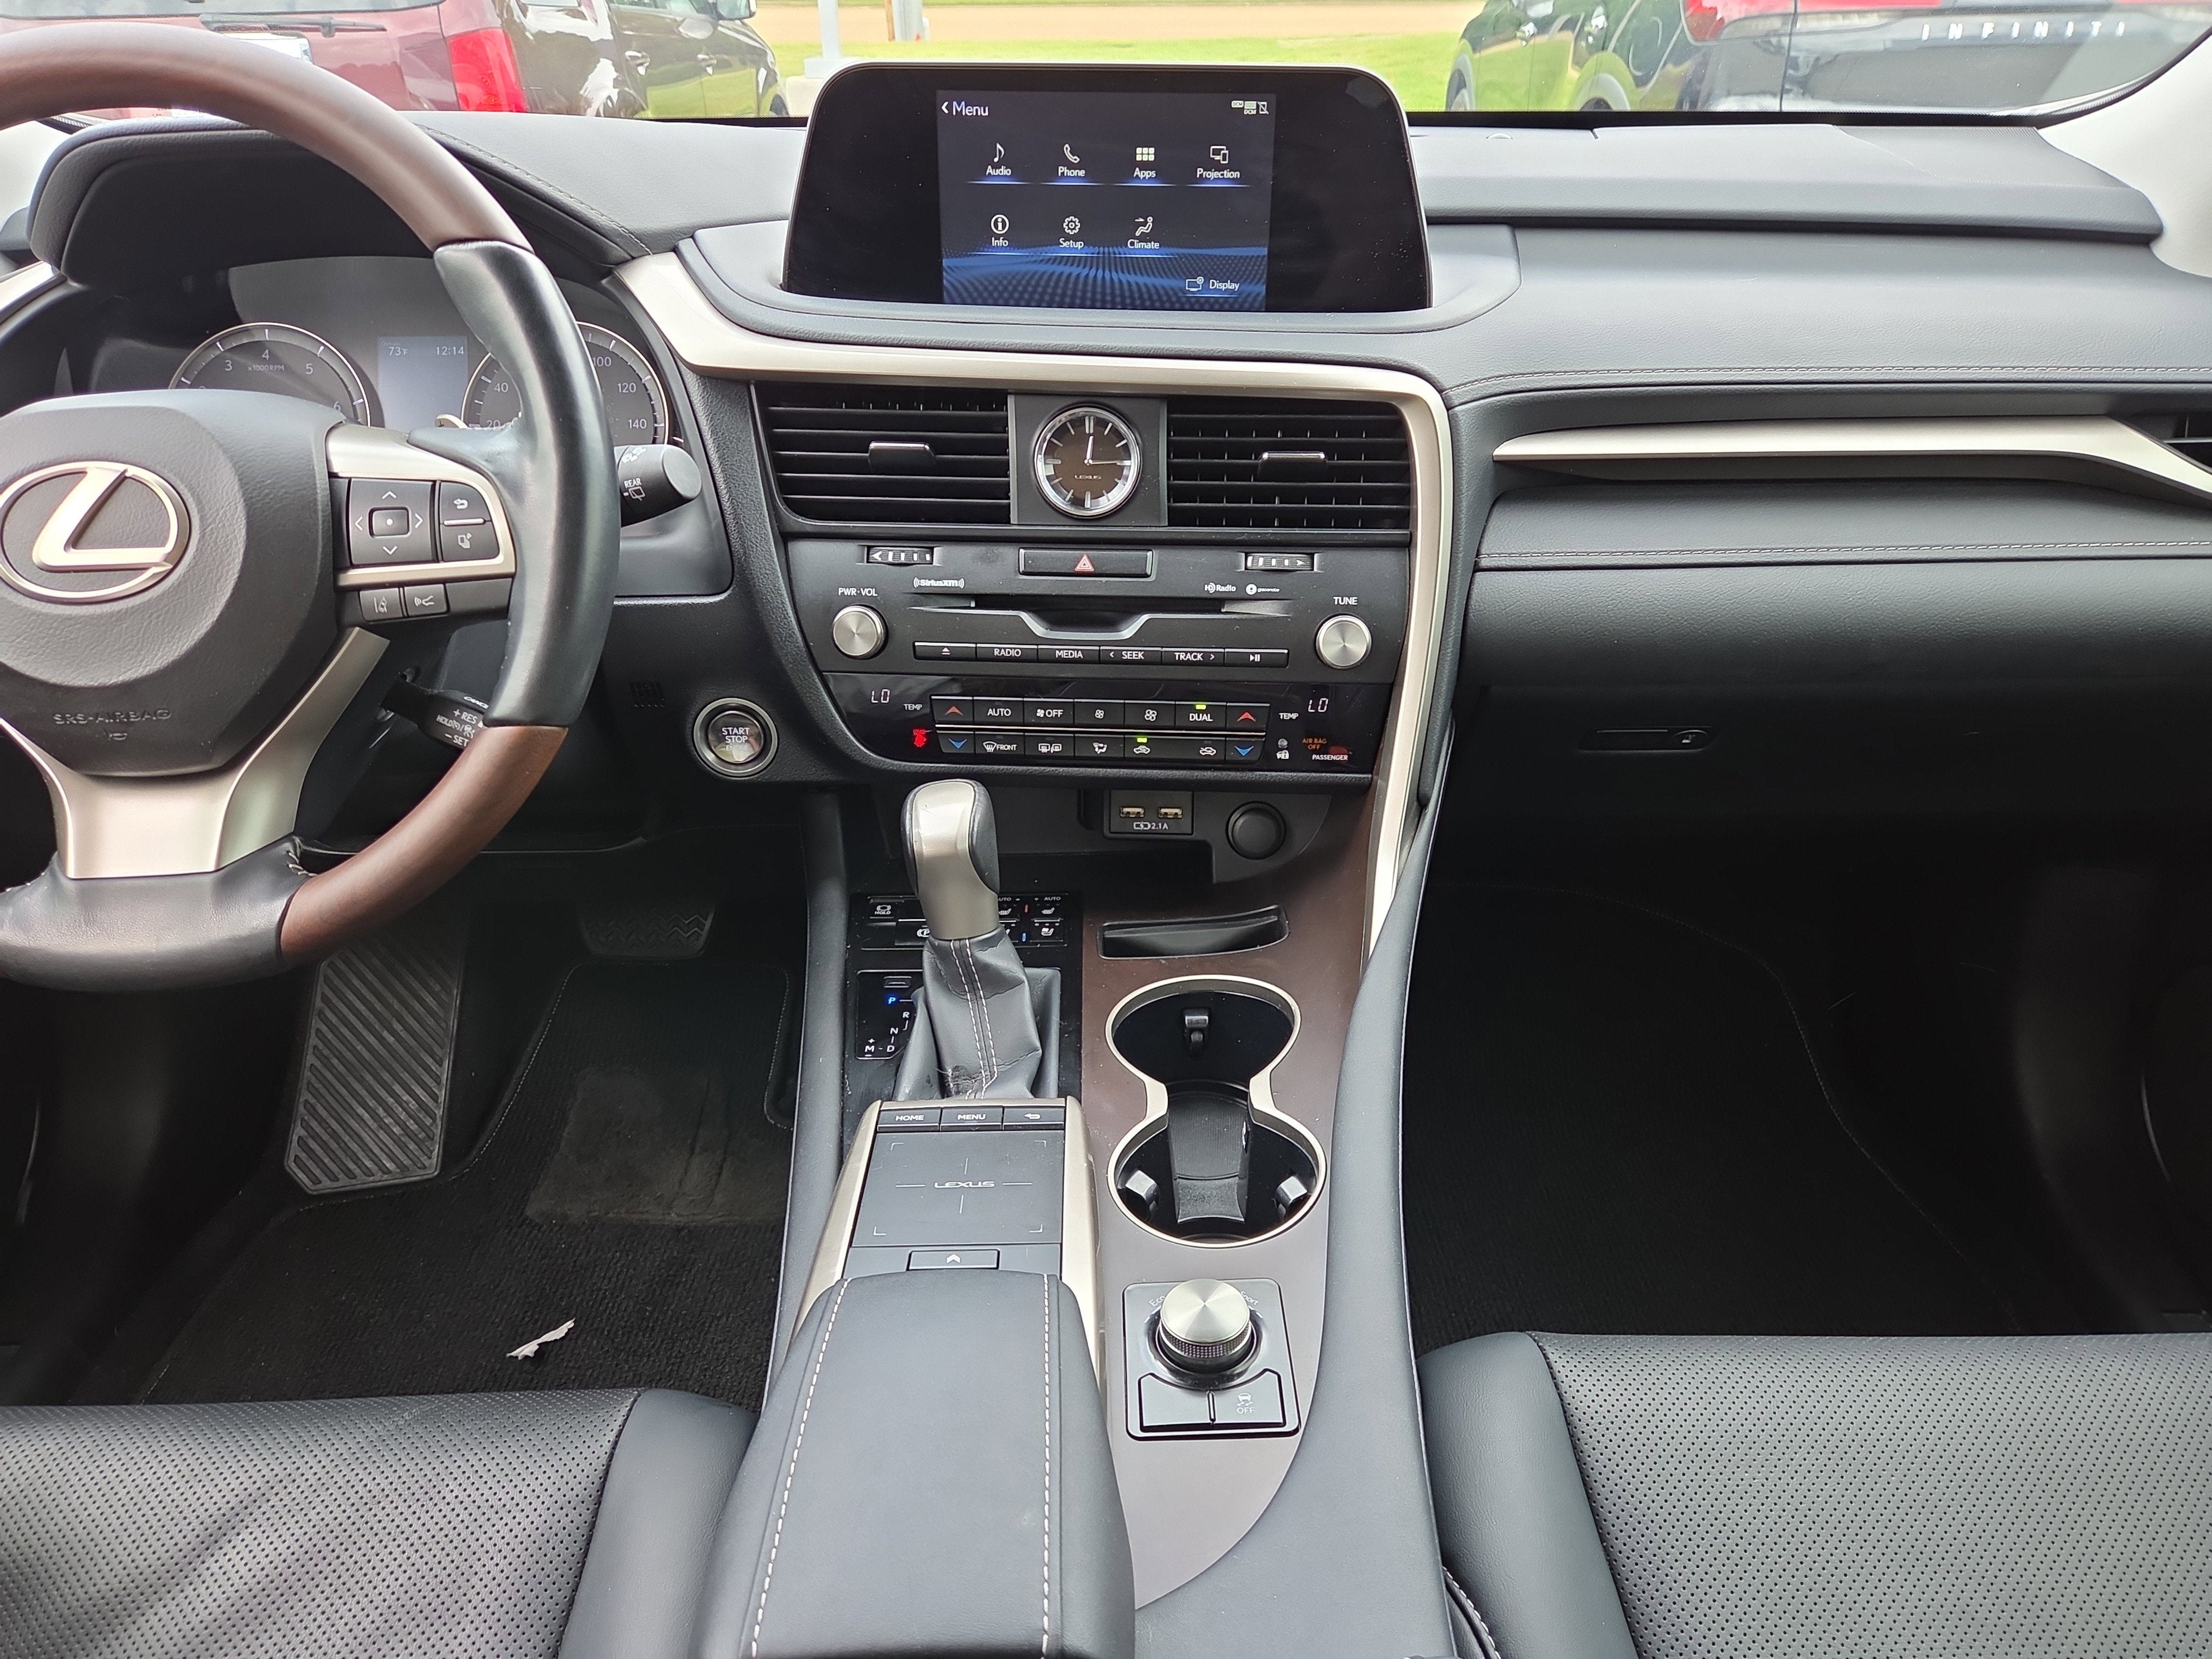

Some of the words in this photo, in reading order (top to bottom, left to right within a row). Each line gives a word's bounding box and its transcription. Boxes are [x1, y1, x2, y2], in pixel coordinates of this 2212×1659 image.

[1921, 21, 2125, 41] INFINITI
[953, 101, 988, 117] Menu
[986, 165, 1011, 176] Audio
[1058, 166, 1085, 177] Phone
[1134, 168, 1156, 179] Apps
[1197, 168, 1240, 179] Projection
[992, 237, 1008, 247] Info
[1059, 239, 1084, 249] Setup
[1127, 239, 1160, 249] Climate
[1209, 280, 1240, 291] Display
[262, 349, 269, 360] 4
[436, 346, 464, 356] 12:14
[224, 360, 233, 371] 3
[593, 356, 612, 366] 100
[306, 363, 313, 375] 5
[494, 382, 509, 393] 40
[618, 382, 636, 393] 120
[333, 401, 341, 411] 6
[628, 419, 647, 429] 140
[624, 478, 642, 488] REAR
[1333, 596, 1358, 605] TUNE
[993, 648, 1021, 657] RADIO
[1055, 650, 1083, 659] MEDIA
[1122, 651, 1144, 660] SEEK
[1174, 652, 1203, 661] TRACK
[987, 708, 1012, 716] AUTO
[1045, 709, 1064, 717] OFF
[461, 711, 478, 724] RES
[1189, 713, 1213, 722] DUAL
[722, 727, 750, 735] START
[453, 735, 470, 747] SET
[996, 743, 1017, 751] FRONT
